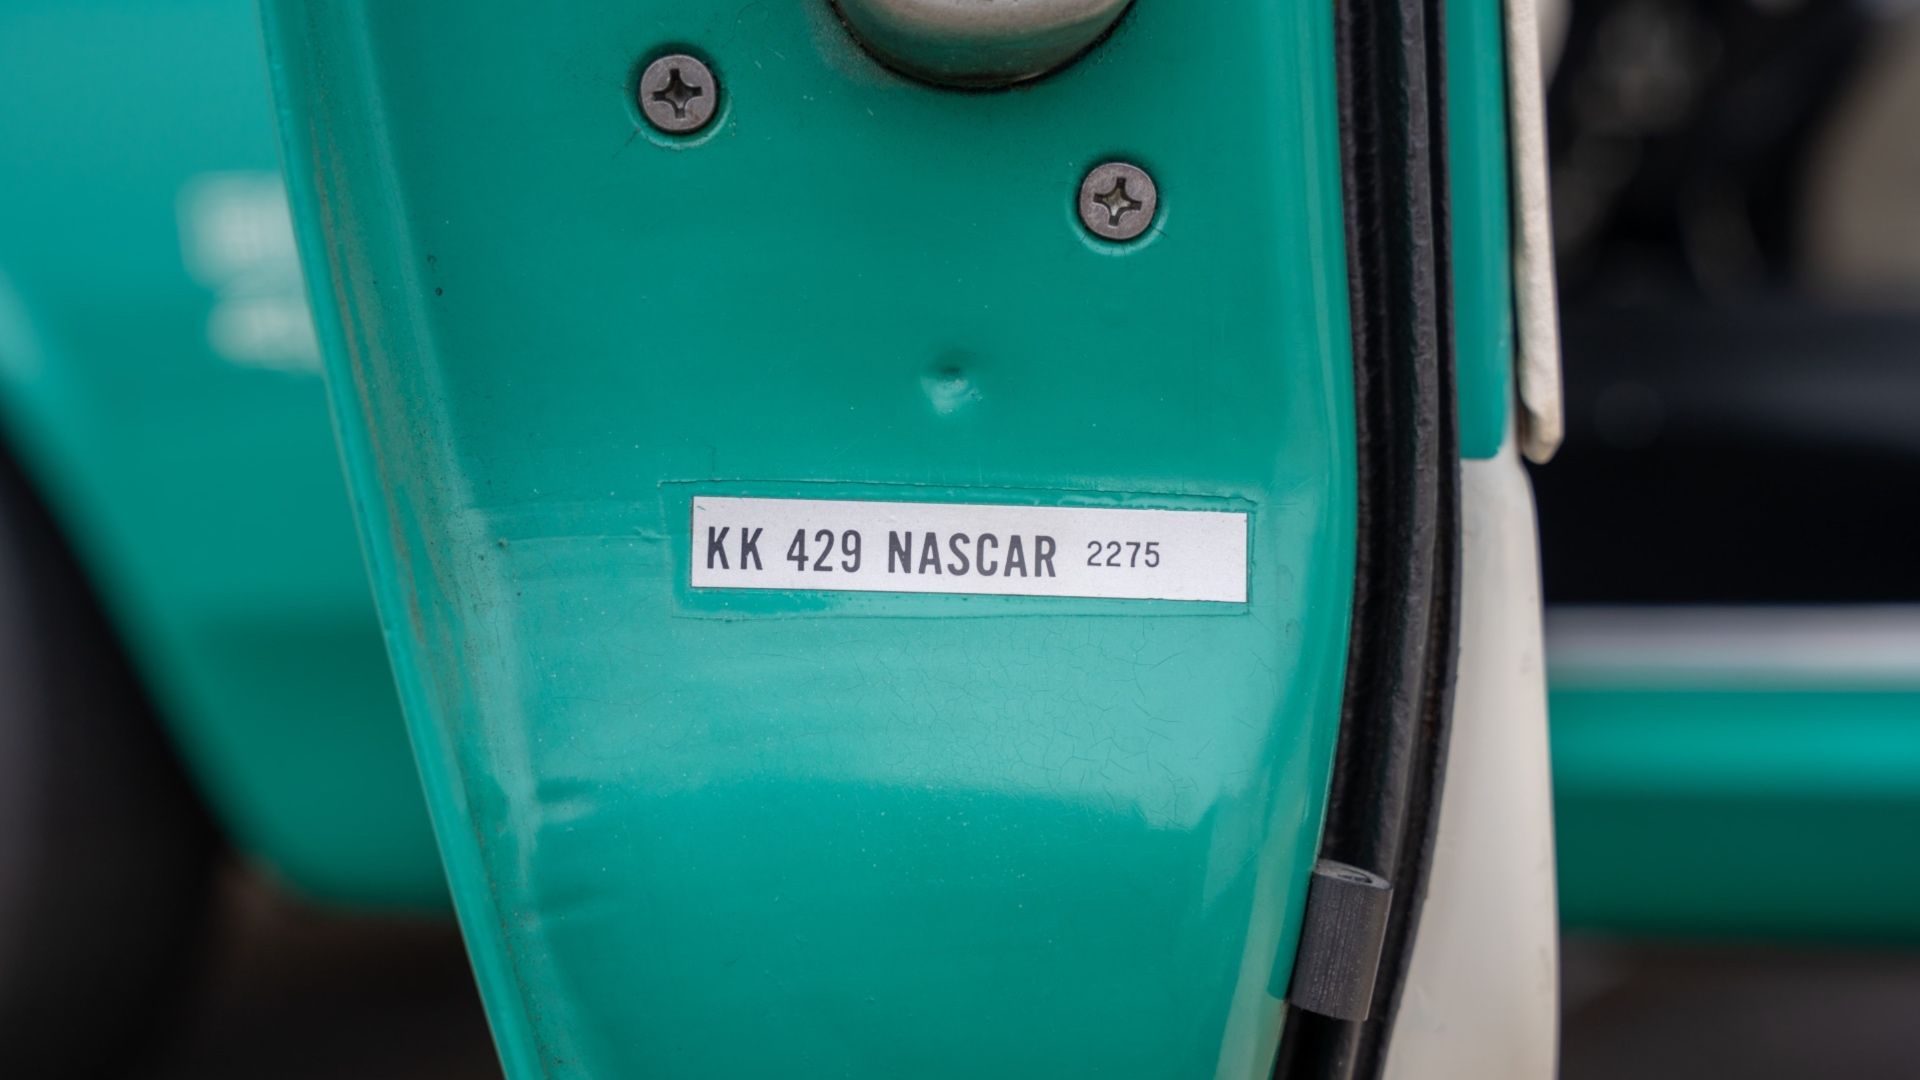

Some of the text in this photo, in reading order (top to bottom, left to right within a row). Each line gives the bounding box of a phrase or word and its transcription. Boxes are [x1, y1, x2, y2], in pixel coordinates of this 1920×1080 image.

[707, 527, 1160, 577] KK 429 NASCAR 2275
